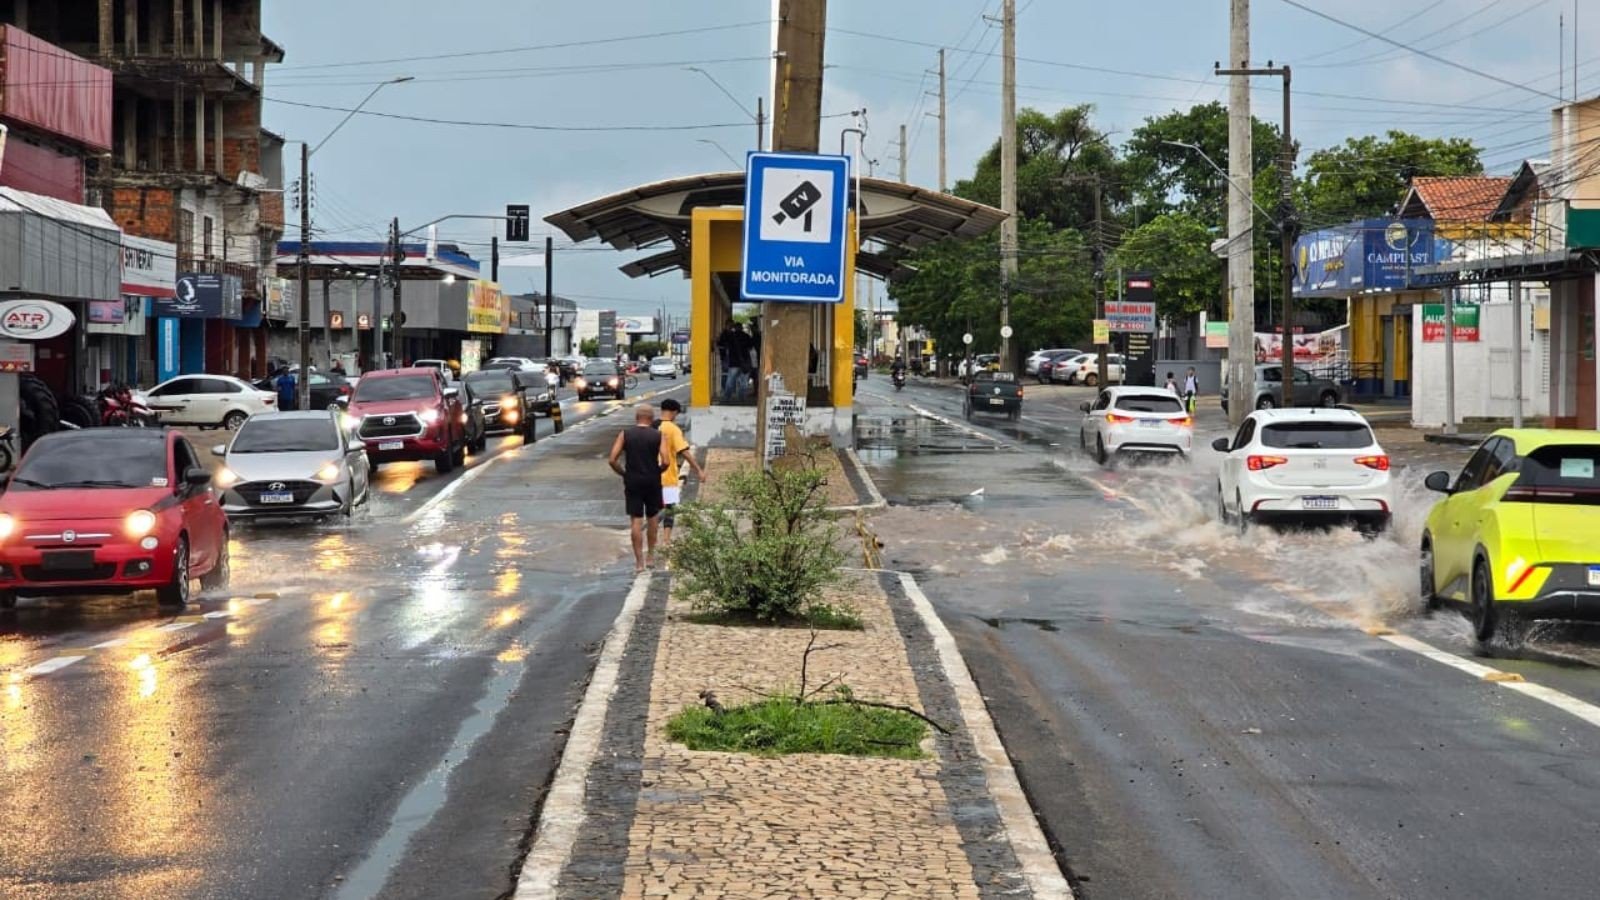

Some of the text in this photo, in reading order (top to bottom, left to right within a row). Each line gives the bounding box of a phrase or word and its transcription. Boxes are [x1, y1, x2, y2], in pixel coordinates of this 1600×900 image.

[790, 191, 808, 208] TV
[784, 256, 805, 268] VIA
[1367, 253, 1429, 264] CAMPLAST
[751, 271, 835, 285] MONITORADA
[7, 312, 44, 322] ATR
